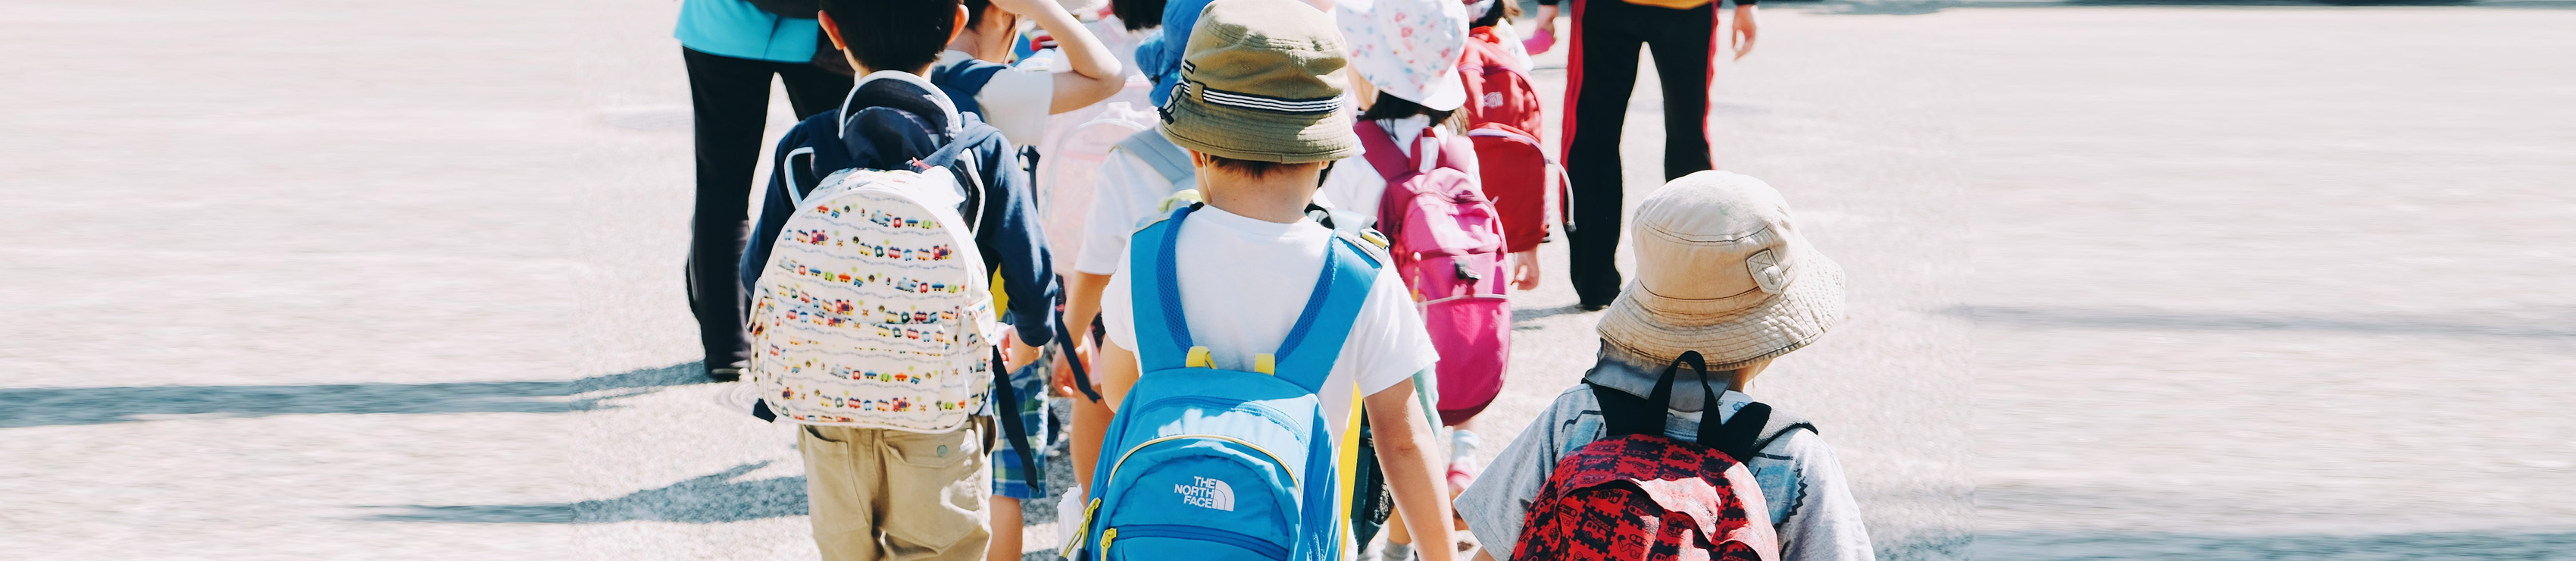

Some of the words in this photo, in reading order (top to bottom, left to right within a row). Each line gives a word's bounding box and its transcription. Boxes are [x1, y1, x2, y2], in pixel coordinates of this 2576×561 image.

[1194, 476, 1216, 489] THE
[1174, 484, 1215, 499] NORTH
[1183, 495, 1213, 509] FACE
